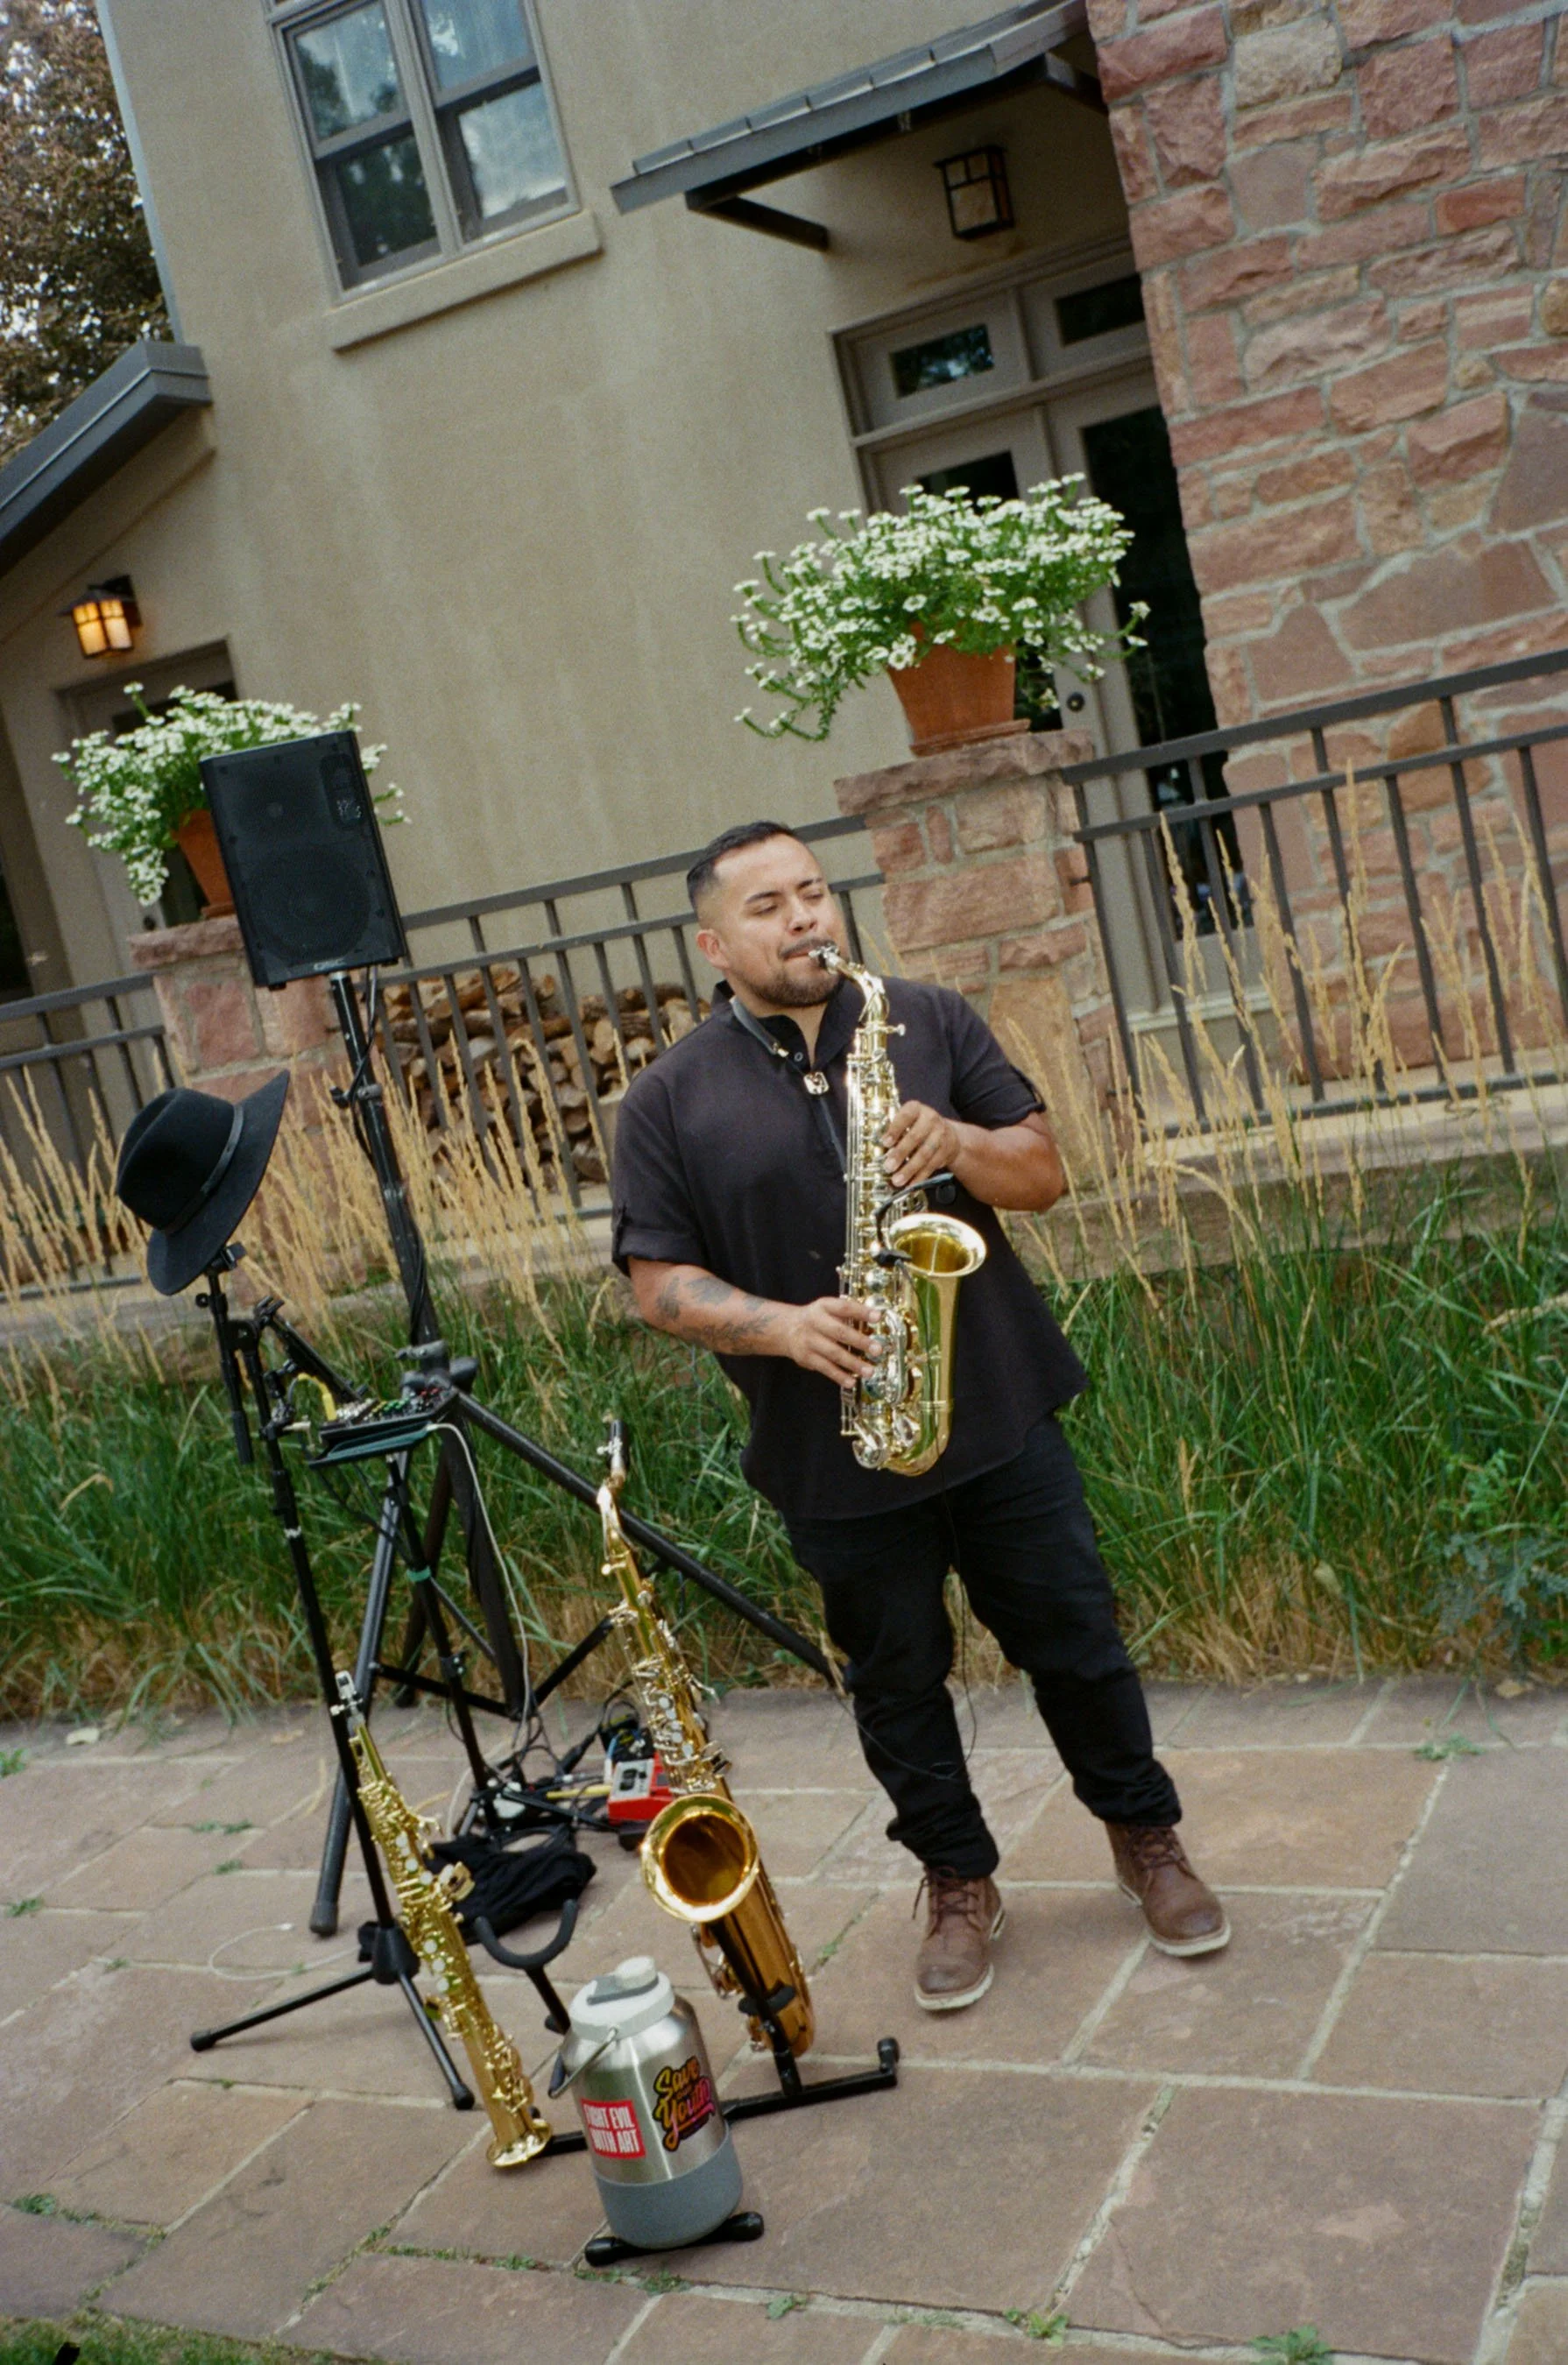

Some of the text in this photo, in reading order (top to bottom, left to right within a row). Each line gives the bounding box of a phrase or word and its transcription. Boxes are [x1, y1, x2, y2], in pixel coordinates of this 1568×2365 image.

[655, 2057, 700, 2101] Save
[609, 2107, 635, 2129] EVIL
[617, 2128, 640, 2153] ART
